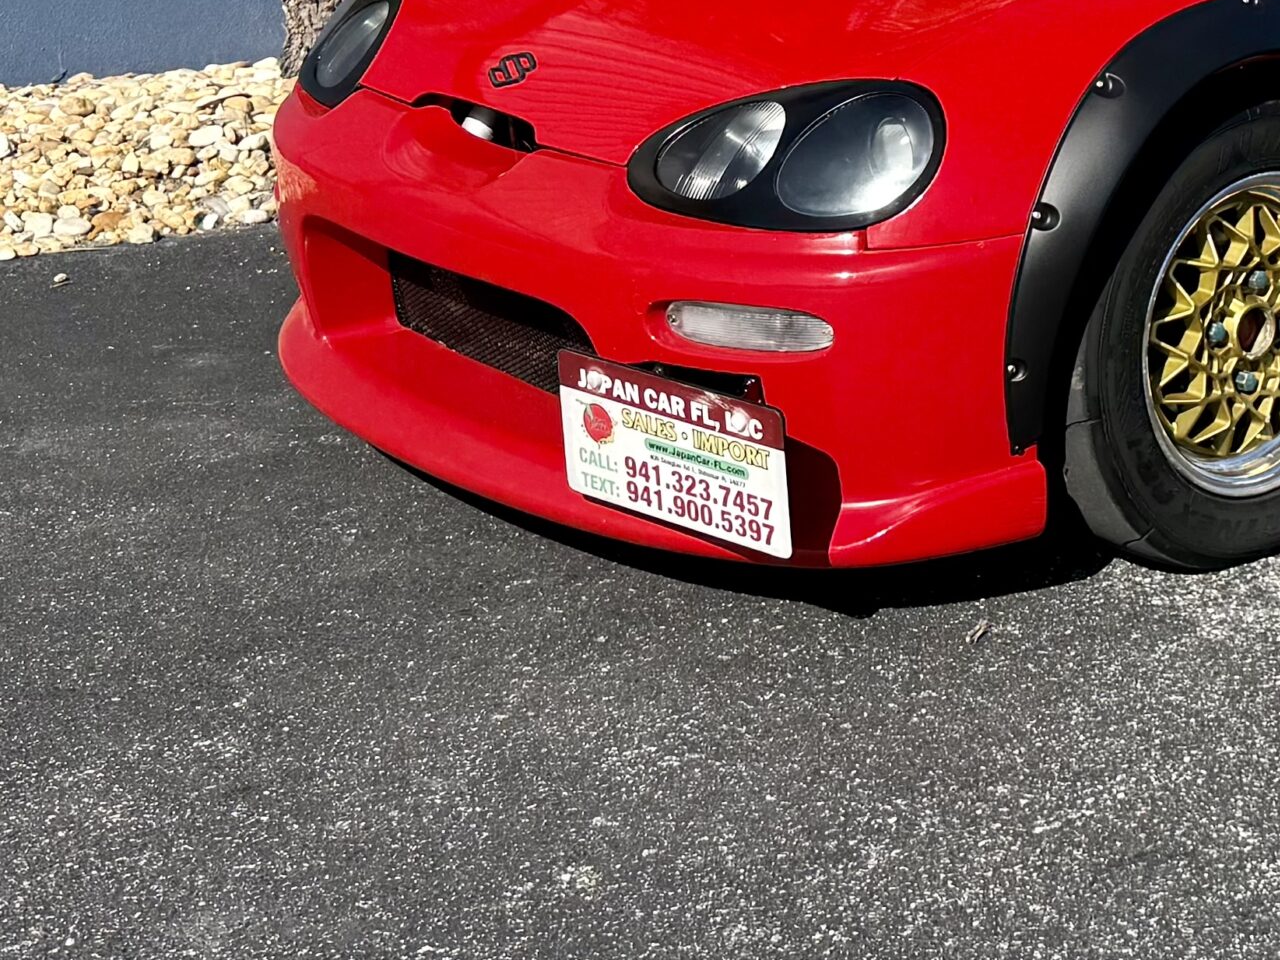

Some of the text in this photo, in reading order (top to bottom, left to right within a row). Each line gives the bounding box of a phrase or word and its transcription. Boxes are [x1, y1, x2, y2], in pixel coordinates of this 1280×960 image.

[578, 368, 764, 440] JPAN CAR FL, LC
[621, 408, 771, 470] SALES IMPORT
[579, 447, 619, 474] CALL:
[624, 455, 773, 521] 941.323.7457
[581, 471, 621, 498] TEXT:
[626, 480, 775, 546] 941.900.5397
